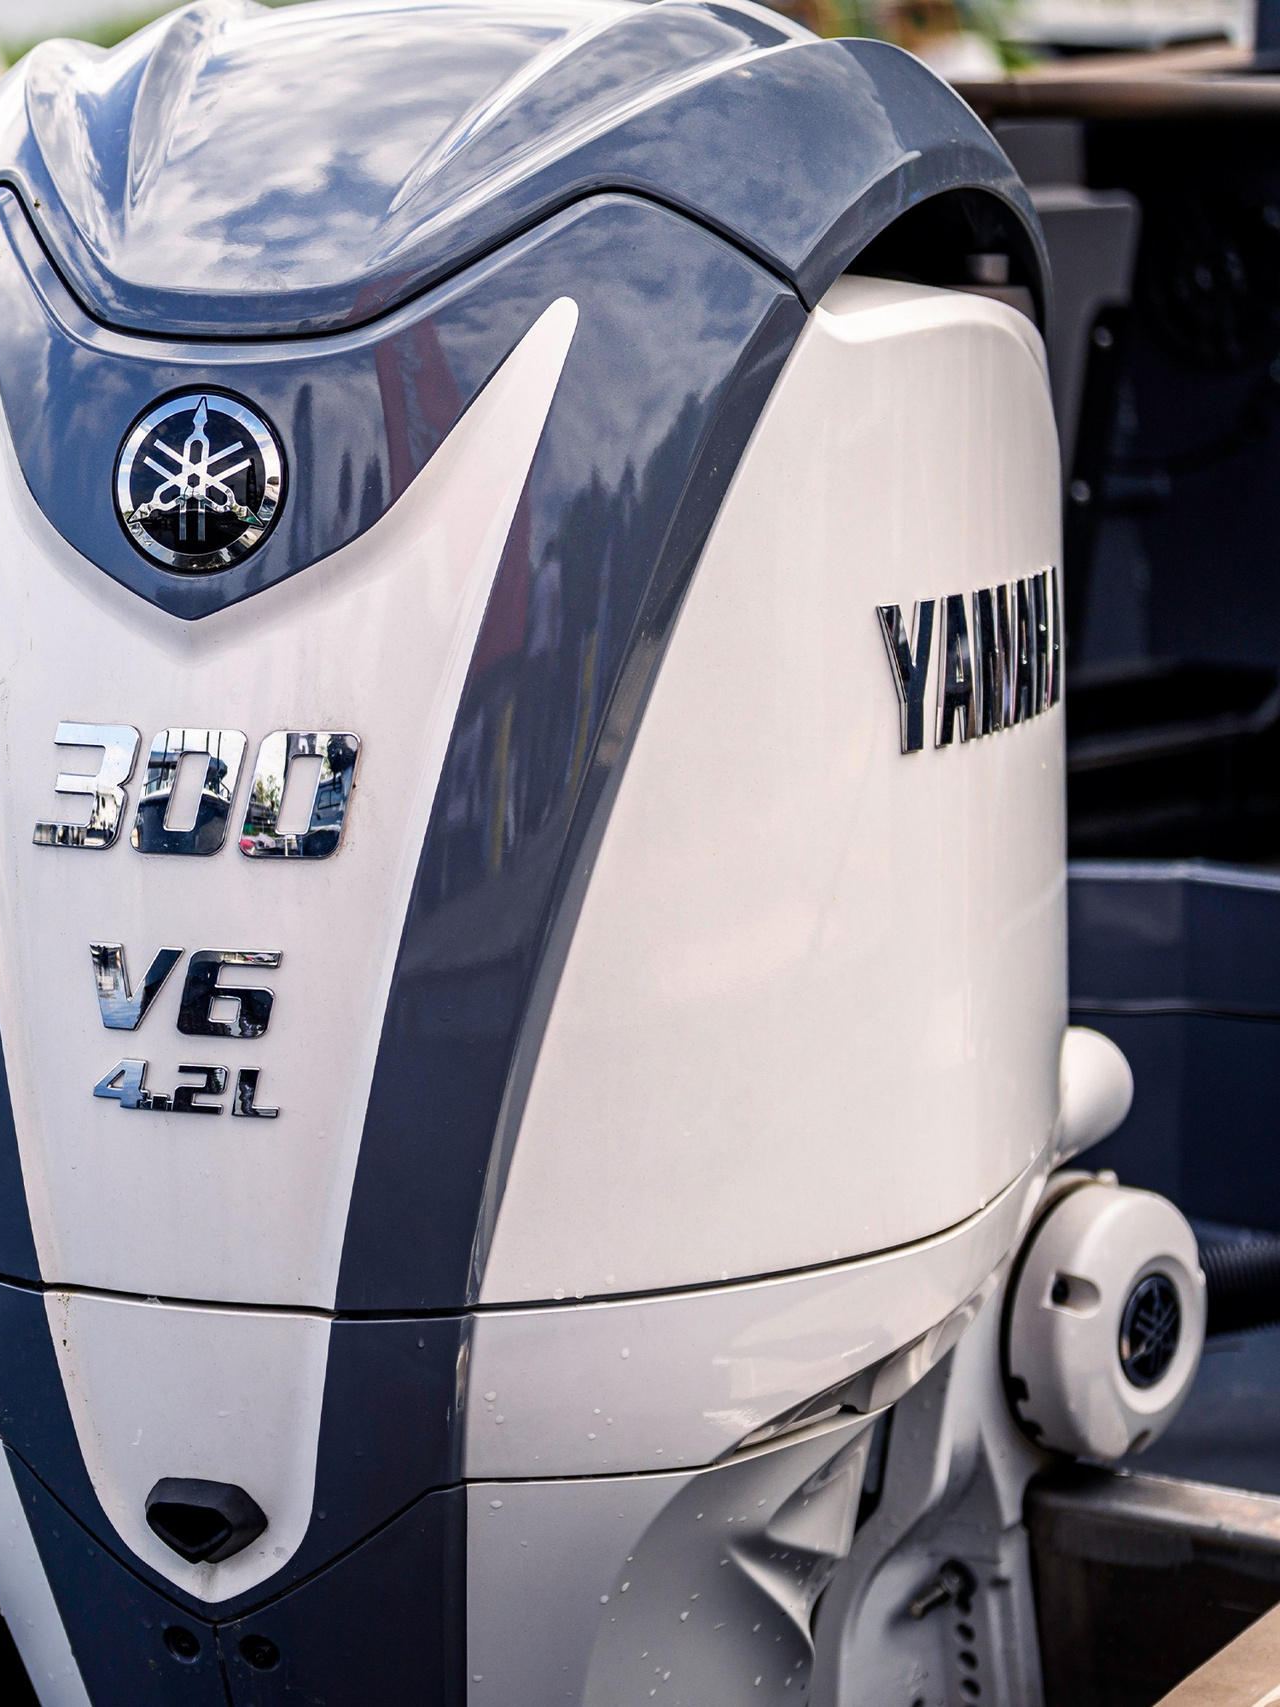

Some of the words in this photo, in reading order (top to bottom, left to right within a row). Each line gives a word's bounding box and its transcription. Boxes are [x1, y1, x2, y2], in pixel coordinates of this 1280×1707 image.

[32, 720, 361, 860] 300
[89, 941, 283, 1039] V6
[93, 1058, 280, 1118] 4.2L
